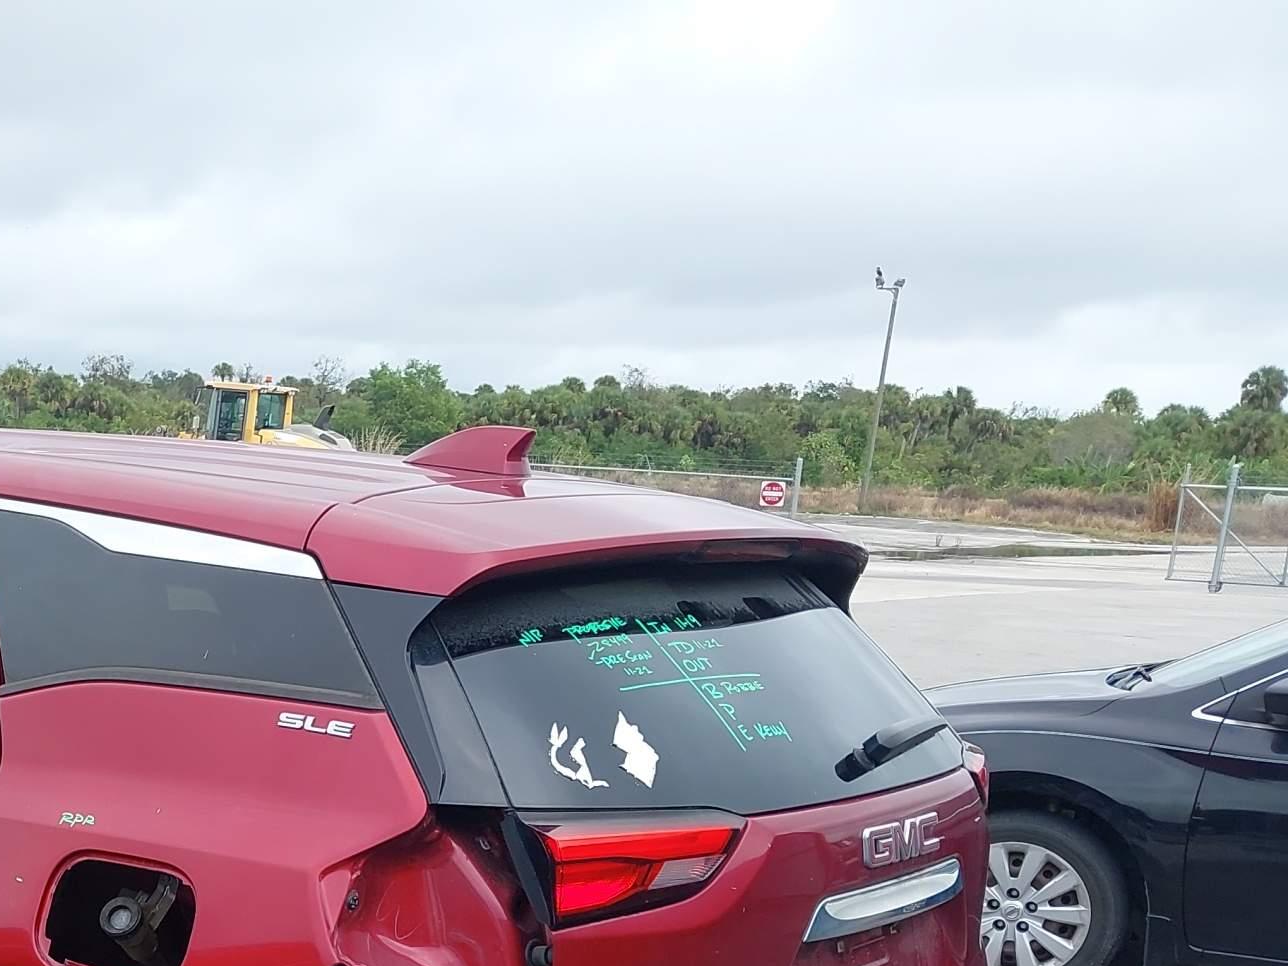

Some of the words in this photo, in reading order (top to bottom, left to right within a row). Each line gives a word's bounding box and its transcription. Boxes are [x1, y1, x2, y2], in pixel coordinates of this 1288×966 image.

[682, 656, 713, 672] OUT
[277, 712, 356, 738] SLE
[862, 811, 940, 868] GMC
